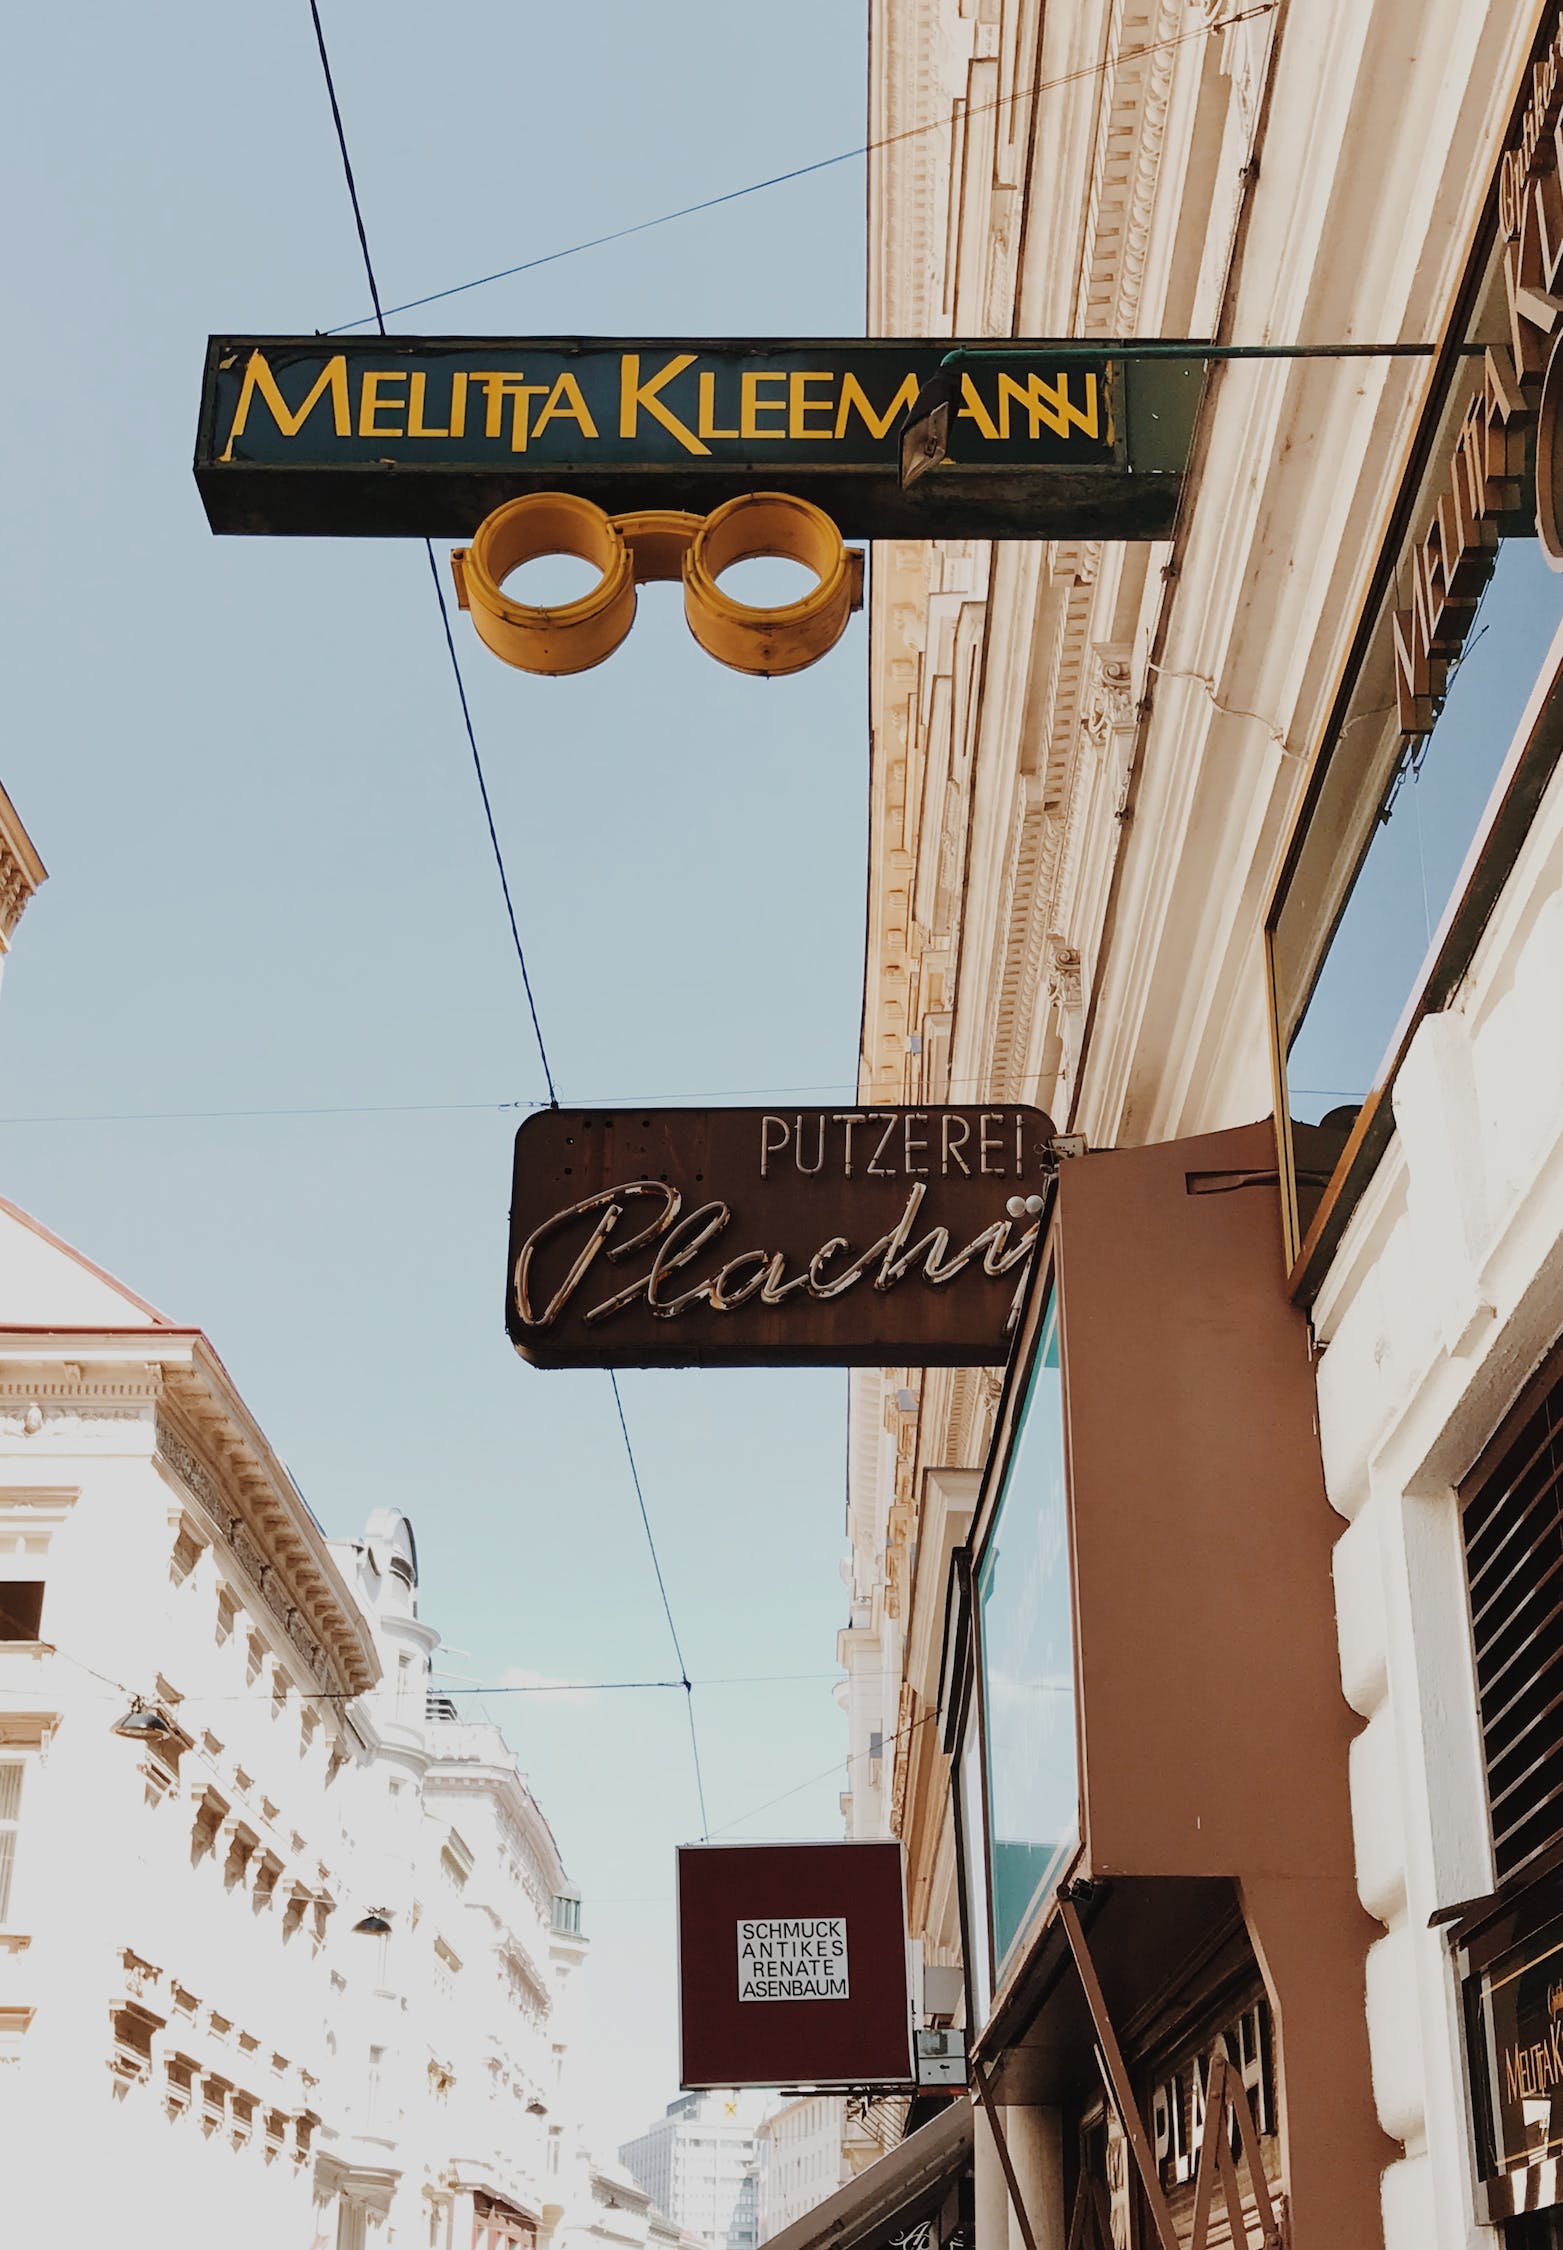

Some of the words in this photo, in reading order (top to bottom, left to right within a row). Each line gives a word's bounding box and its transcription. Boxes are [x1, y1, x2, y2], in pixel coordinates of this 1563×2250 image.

[221, 350, 598, 461] MELITTA
[619, 354, 1098, 455] KLEEMANN
[761, 1113, 1023, 1180] PUTZEREI
[742, 1921, 841, 1939] SCHMUCK
[742, 1940, 844, 1958] ANTIKES
[753, 1960, 834, 1977] RENATE
[743, 1979, 846, 1998] ASENBAUM
